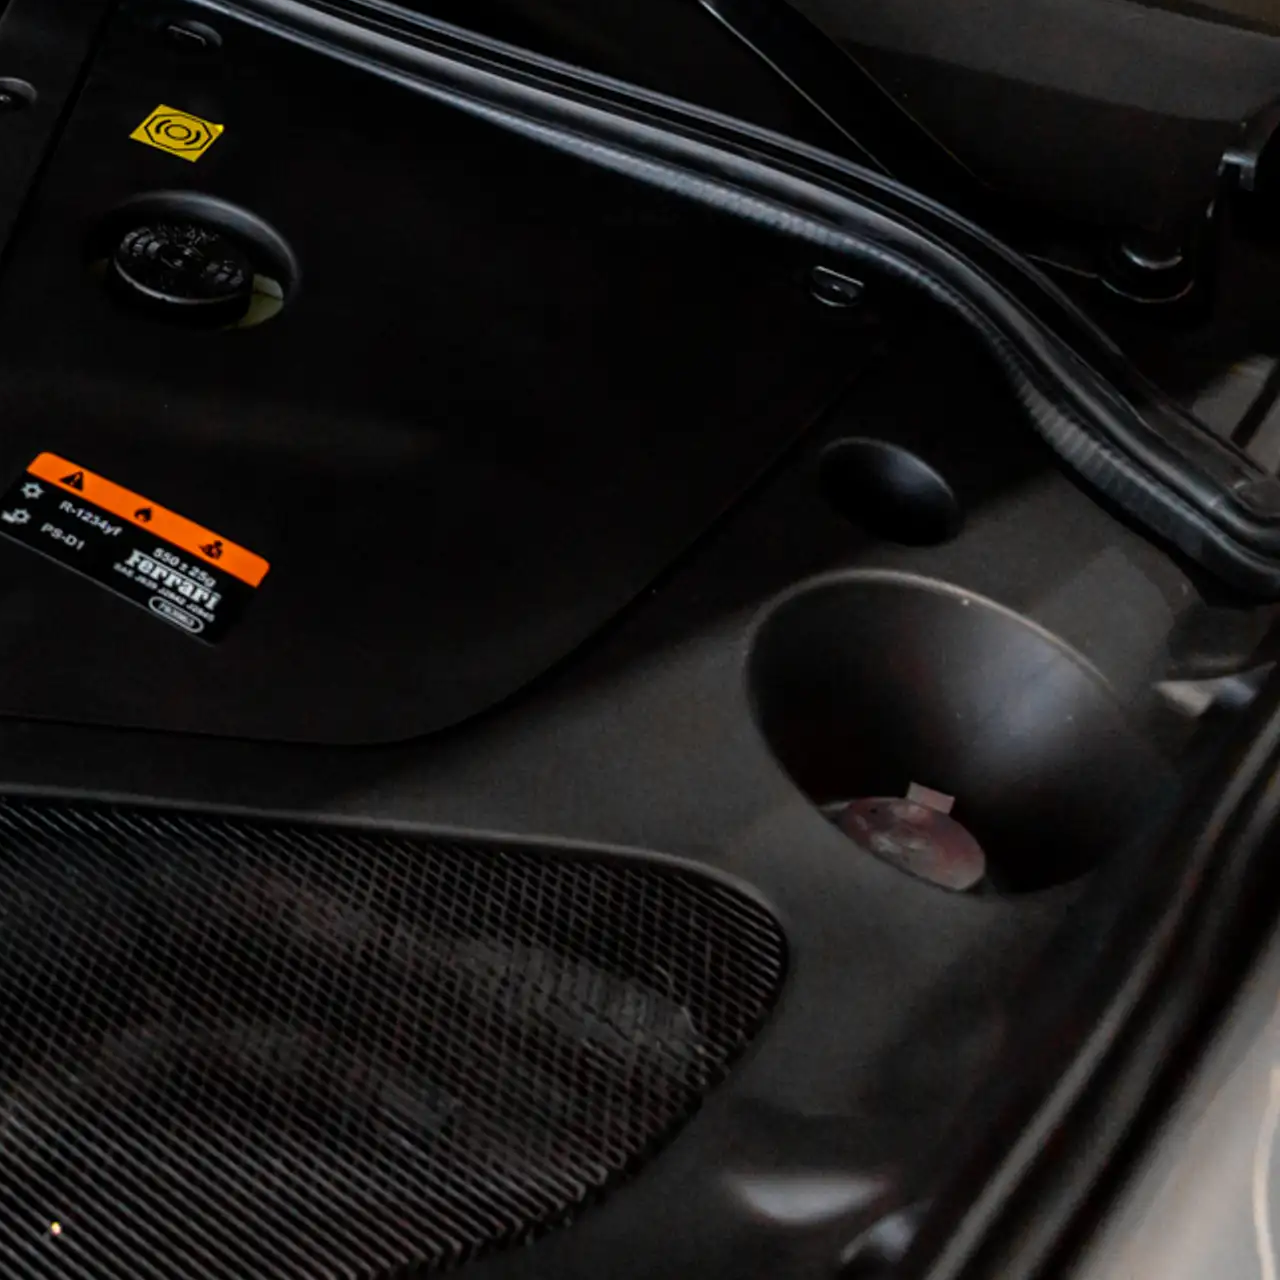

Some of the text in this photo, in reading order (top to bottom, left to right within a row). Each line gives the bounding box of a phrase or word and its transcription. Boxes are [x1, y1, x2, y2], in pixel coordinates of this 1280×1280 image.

[40, 522, 85, 550] PS-D1
[59, 500, 123, 536] R-1234yf
[124, 549, 222, 611] Ferrari
